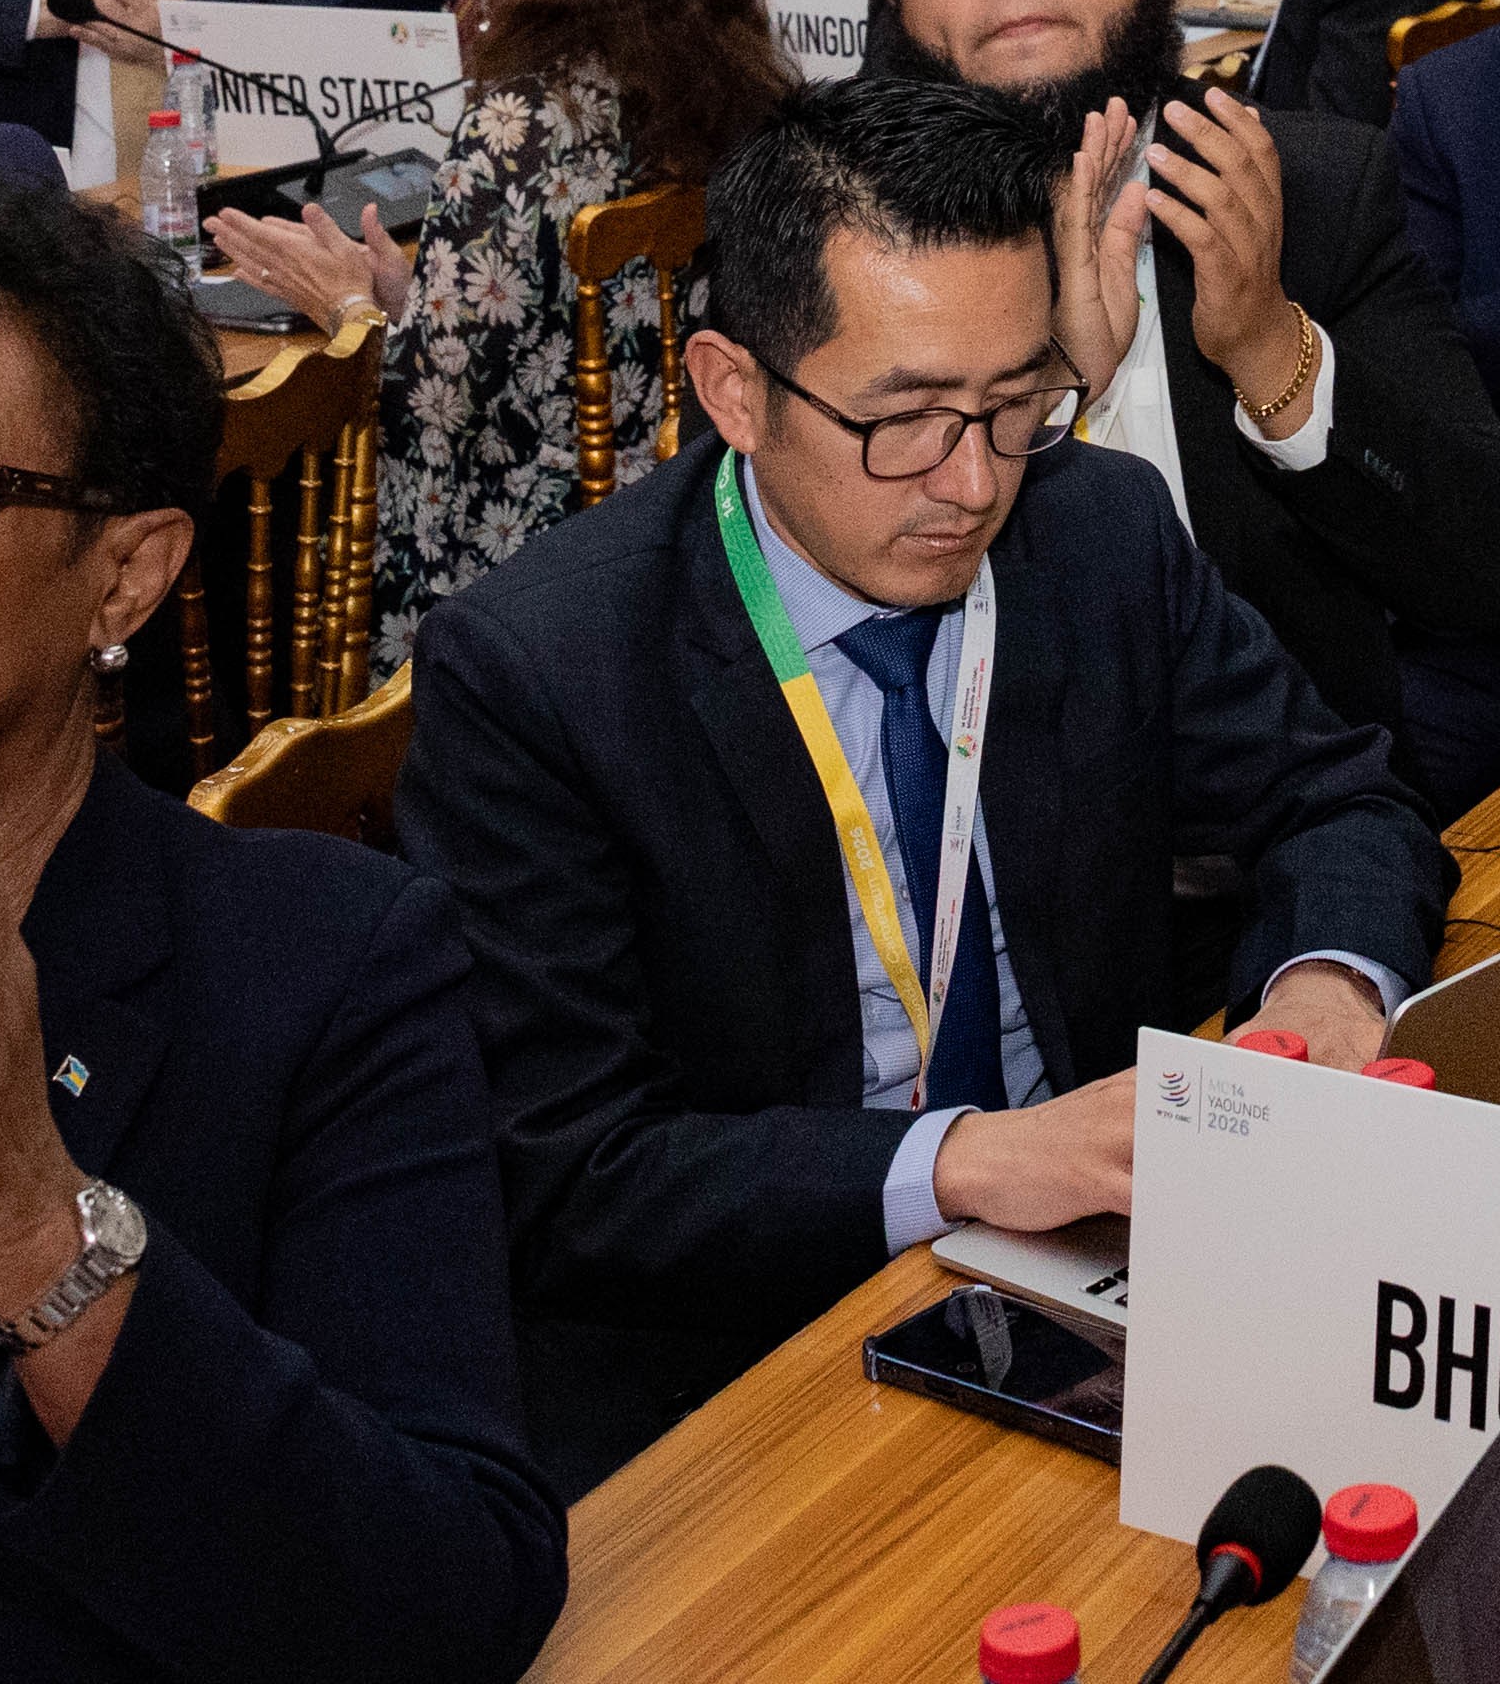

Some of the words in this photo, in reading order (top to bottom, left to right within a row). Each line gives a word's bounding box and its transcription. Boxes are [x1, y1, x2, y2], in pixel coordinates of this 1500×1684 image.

[777, 11, 868, 58] KINGDO
[320, 76, 435, 124] STATES
[850, 826, 875, 872] 2026
[1209, 1078, 1244, 1098] MC14
[1207, 1094, 1271, 1122] YAOUNDÉ
[1207, 1112, 1251, 1137] 2026
